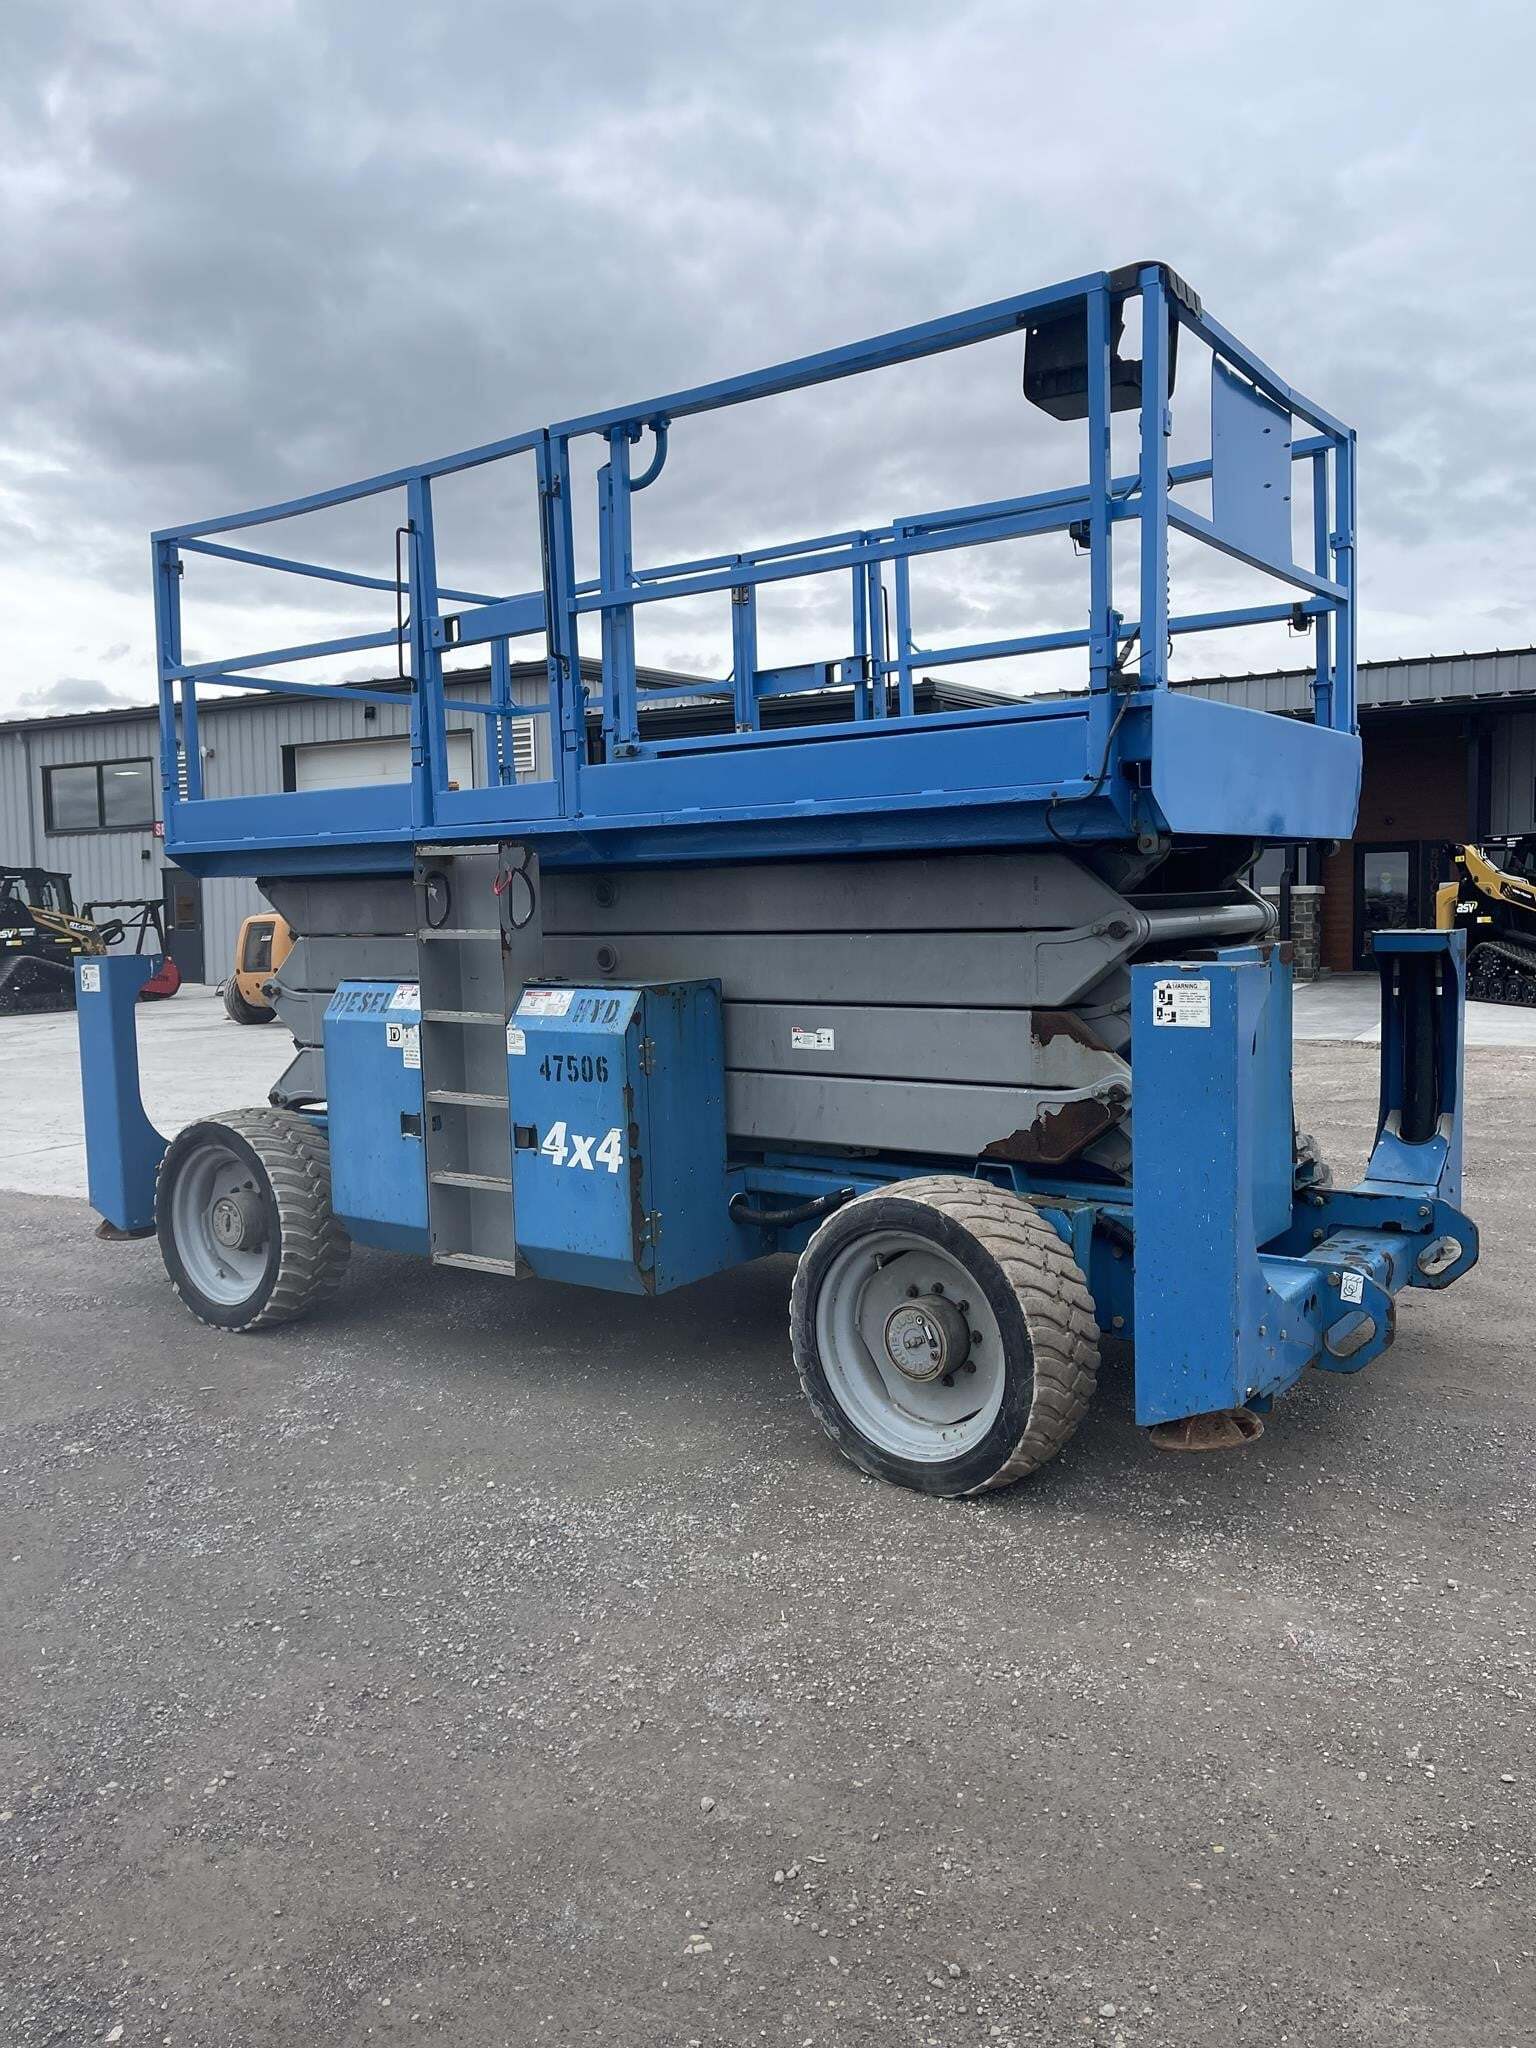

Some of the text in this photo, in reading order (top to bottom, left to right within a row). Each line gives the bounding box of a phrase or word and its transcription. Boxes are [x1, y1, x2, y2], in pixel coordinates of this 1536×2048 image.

[329, 991, 391, 1013] DIESEL
[572, 999, 620, 1024] HYD
[539, 1054, 609, 1083] 47506
[540, 1121, 625, 1174] 4x4
